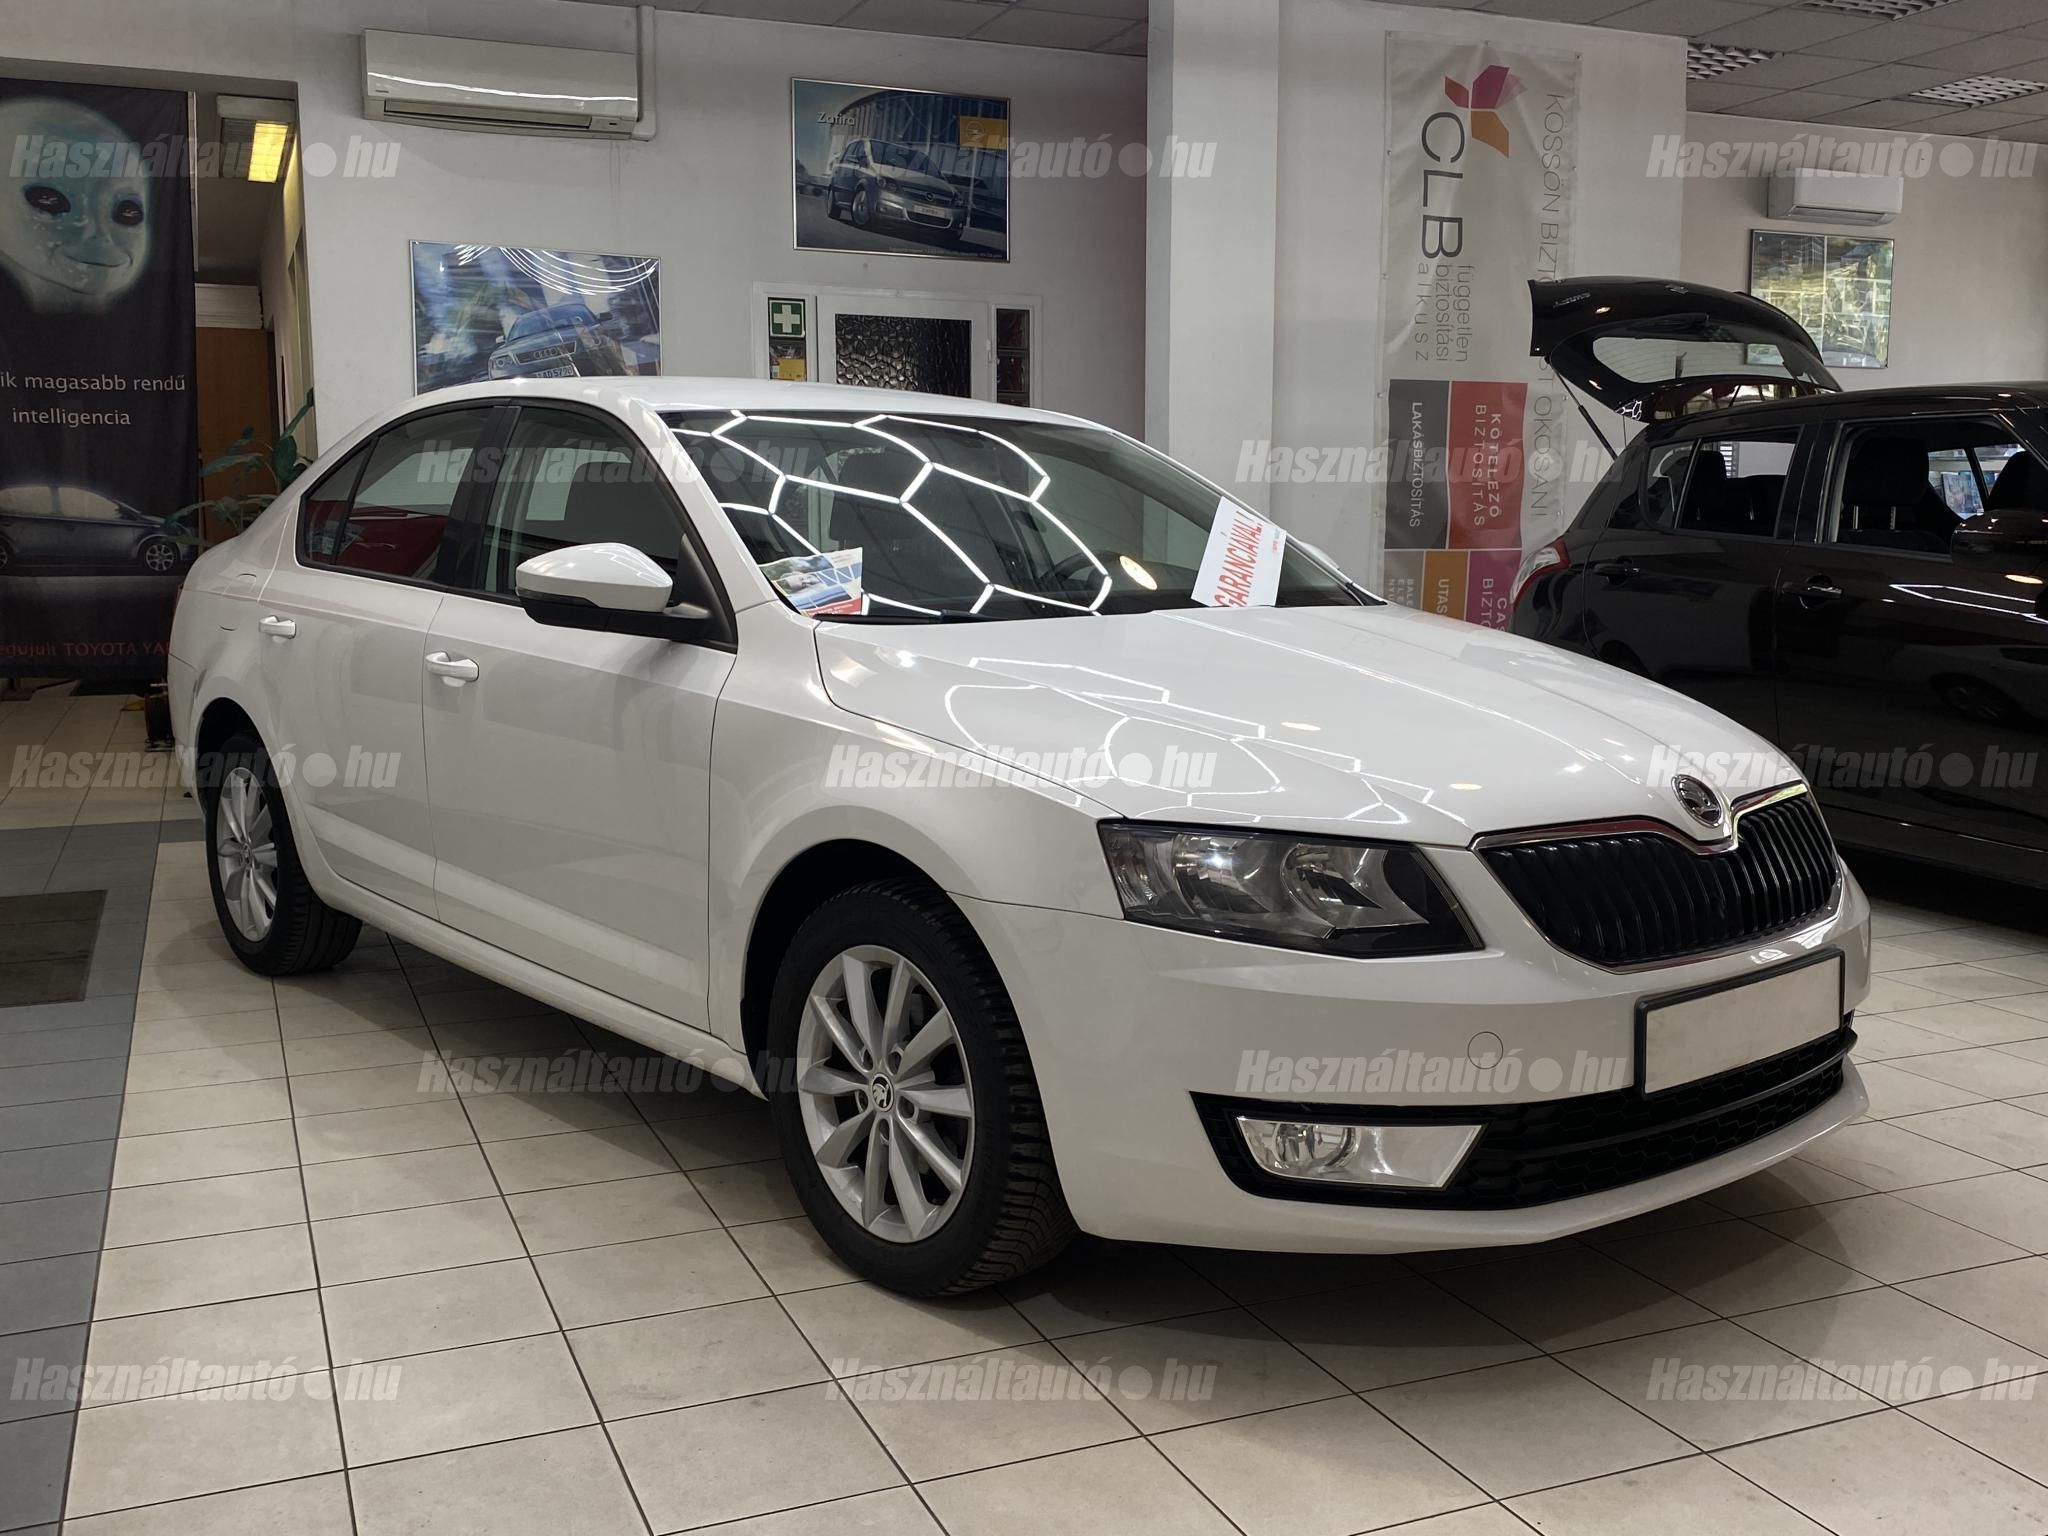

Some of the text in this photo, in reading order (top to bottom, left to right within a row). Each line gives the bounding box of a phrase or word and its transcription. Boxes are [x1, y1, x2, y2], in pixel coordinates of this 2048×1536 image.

[816, 112, 855, 126] Zafira
[1542, 94, 1567, 212] KÖSSÖN
[1421, 112, 1465, 259] CLB
[1415, 263, 1432, 361] alkusz
[1436, 264, 1454, 361] biztosítási
[1453, 265, 1475, 362] független
[12, 408, 131, 428] intelligencia
[25, 374, 127, 393] magasabb
[134, 374, 185, 391] rendű
[1409, 402, 1424, 527] LAKÁSBIZTOSÍTÁS
[1471, 405, 1487, 526] BIZTOSÍTÁS
[1487, 413, 1503, 518] KÖTELEZŐ
[63, 641, 137, 657] TOYOTA
